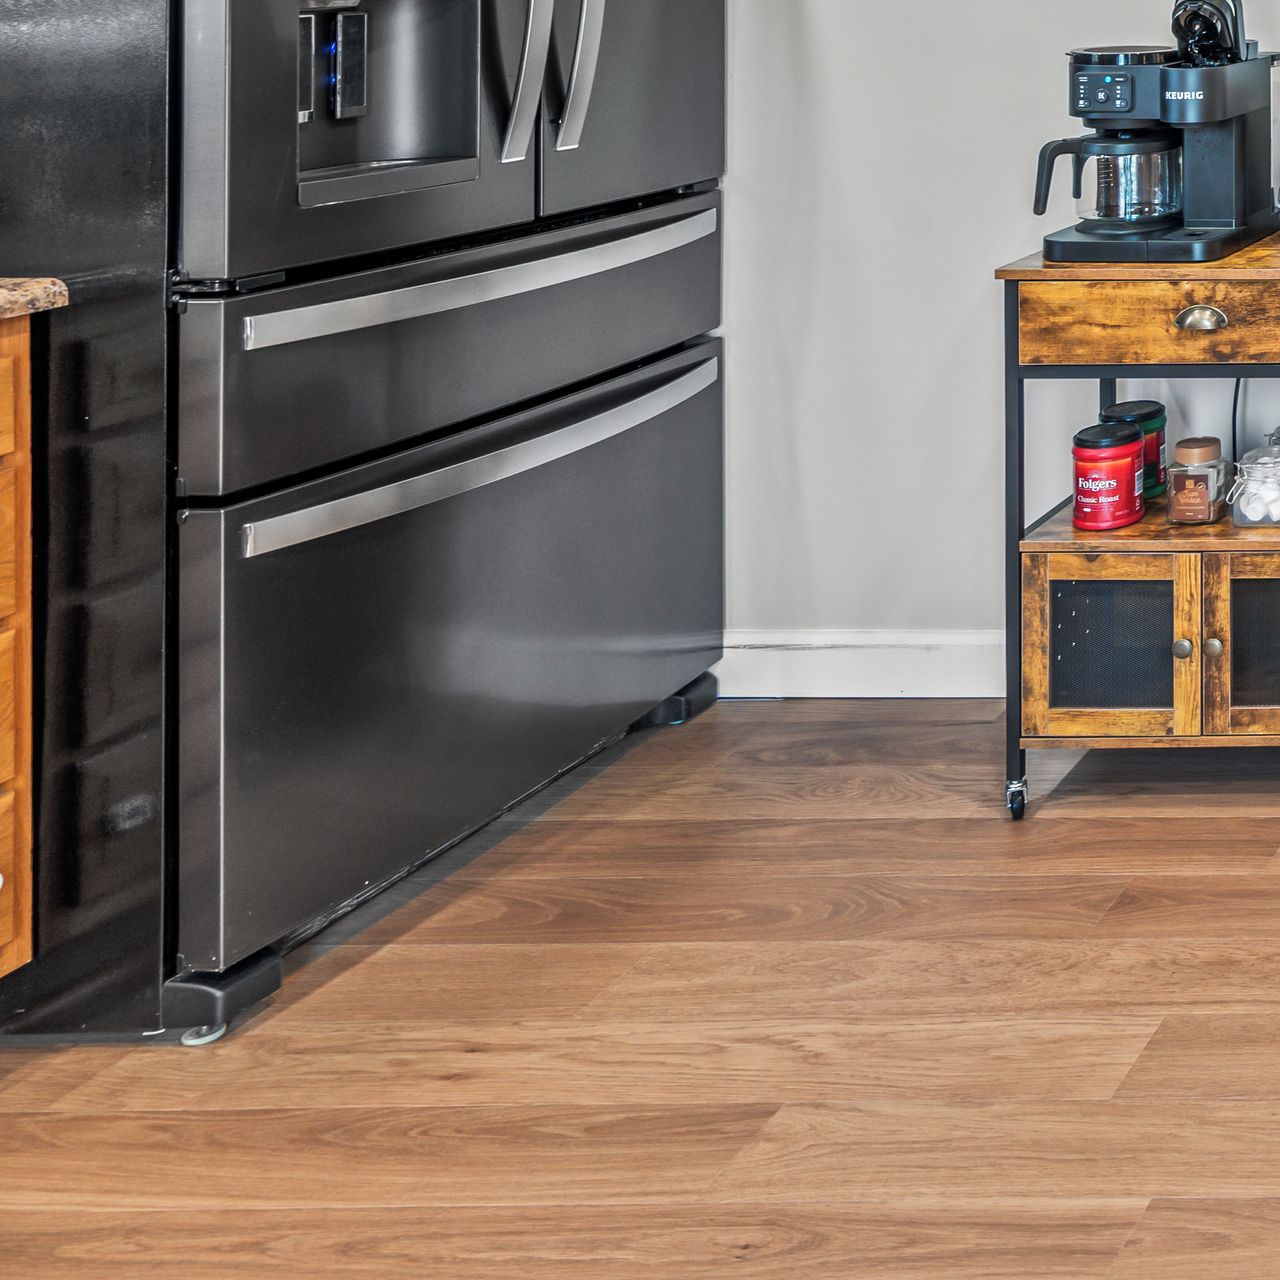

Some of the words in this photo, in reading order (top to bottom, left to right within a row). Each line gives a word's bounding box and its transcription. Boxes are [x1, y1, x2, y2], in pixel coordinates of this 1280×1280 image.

[1165, 91, 1204, 100] KEURIG
[1078, 477, 1117, 492] Folgers
[1077, 495, 1098, 503] Classic
[1098, 494, 1120, 504] Roast
